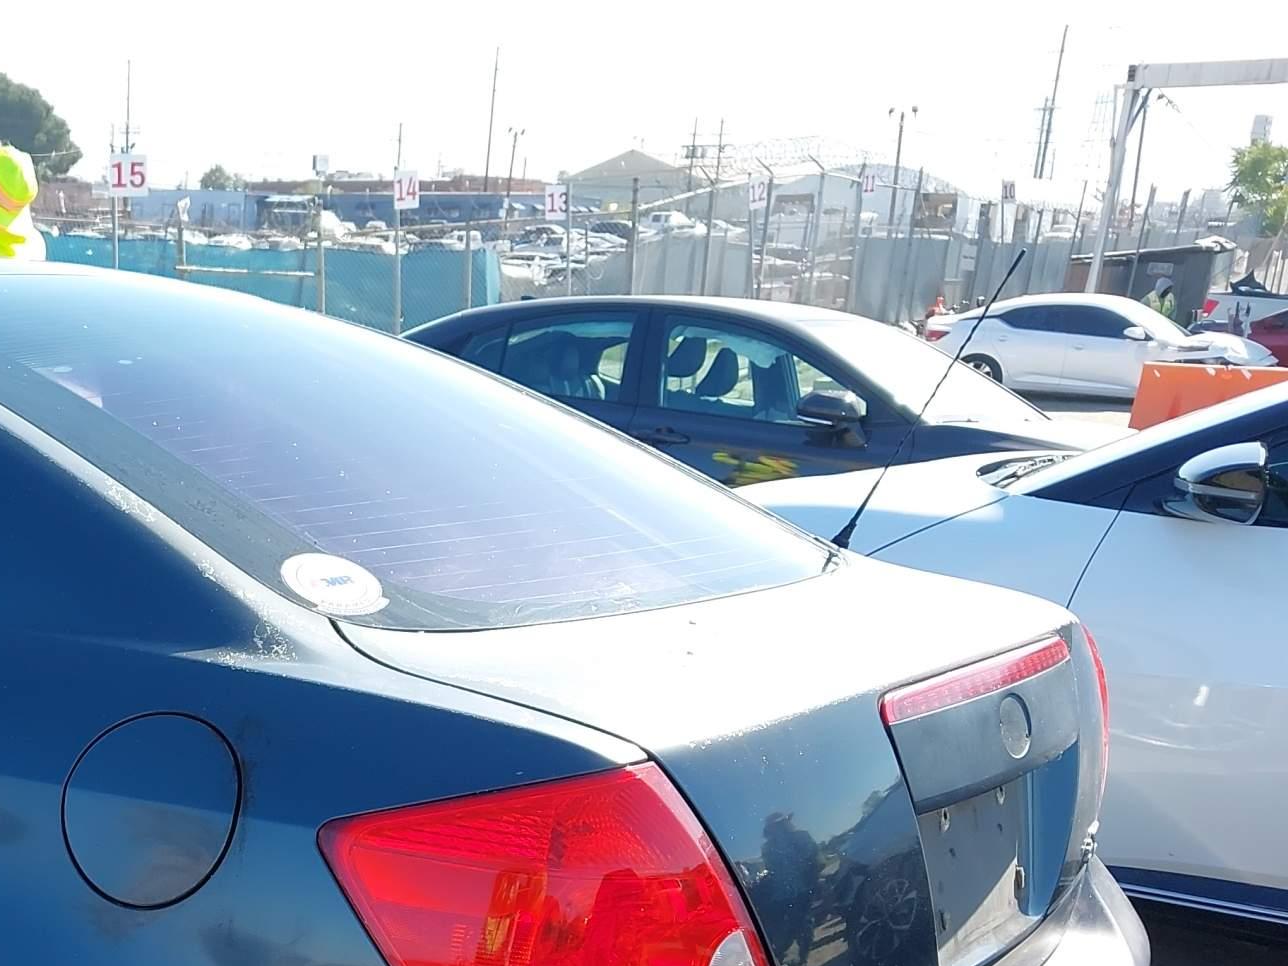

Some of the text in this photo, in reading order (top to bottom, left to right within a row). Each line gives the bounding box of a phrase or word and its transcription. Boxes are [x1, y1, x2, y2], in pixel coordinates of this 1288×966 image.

[111, 161, 145, 188] 15
[864, 175, 875, 193] 11
[396, 176, 417, 202] 14
[751, 181, 766, 203] 12
[1003, 183, 1016, 200] 10
[547, 191, 568, 213] 13
